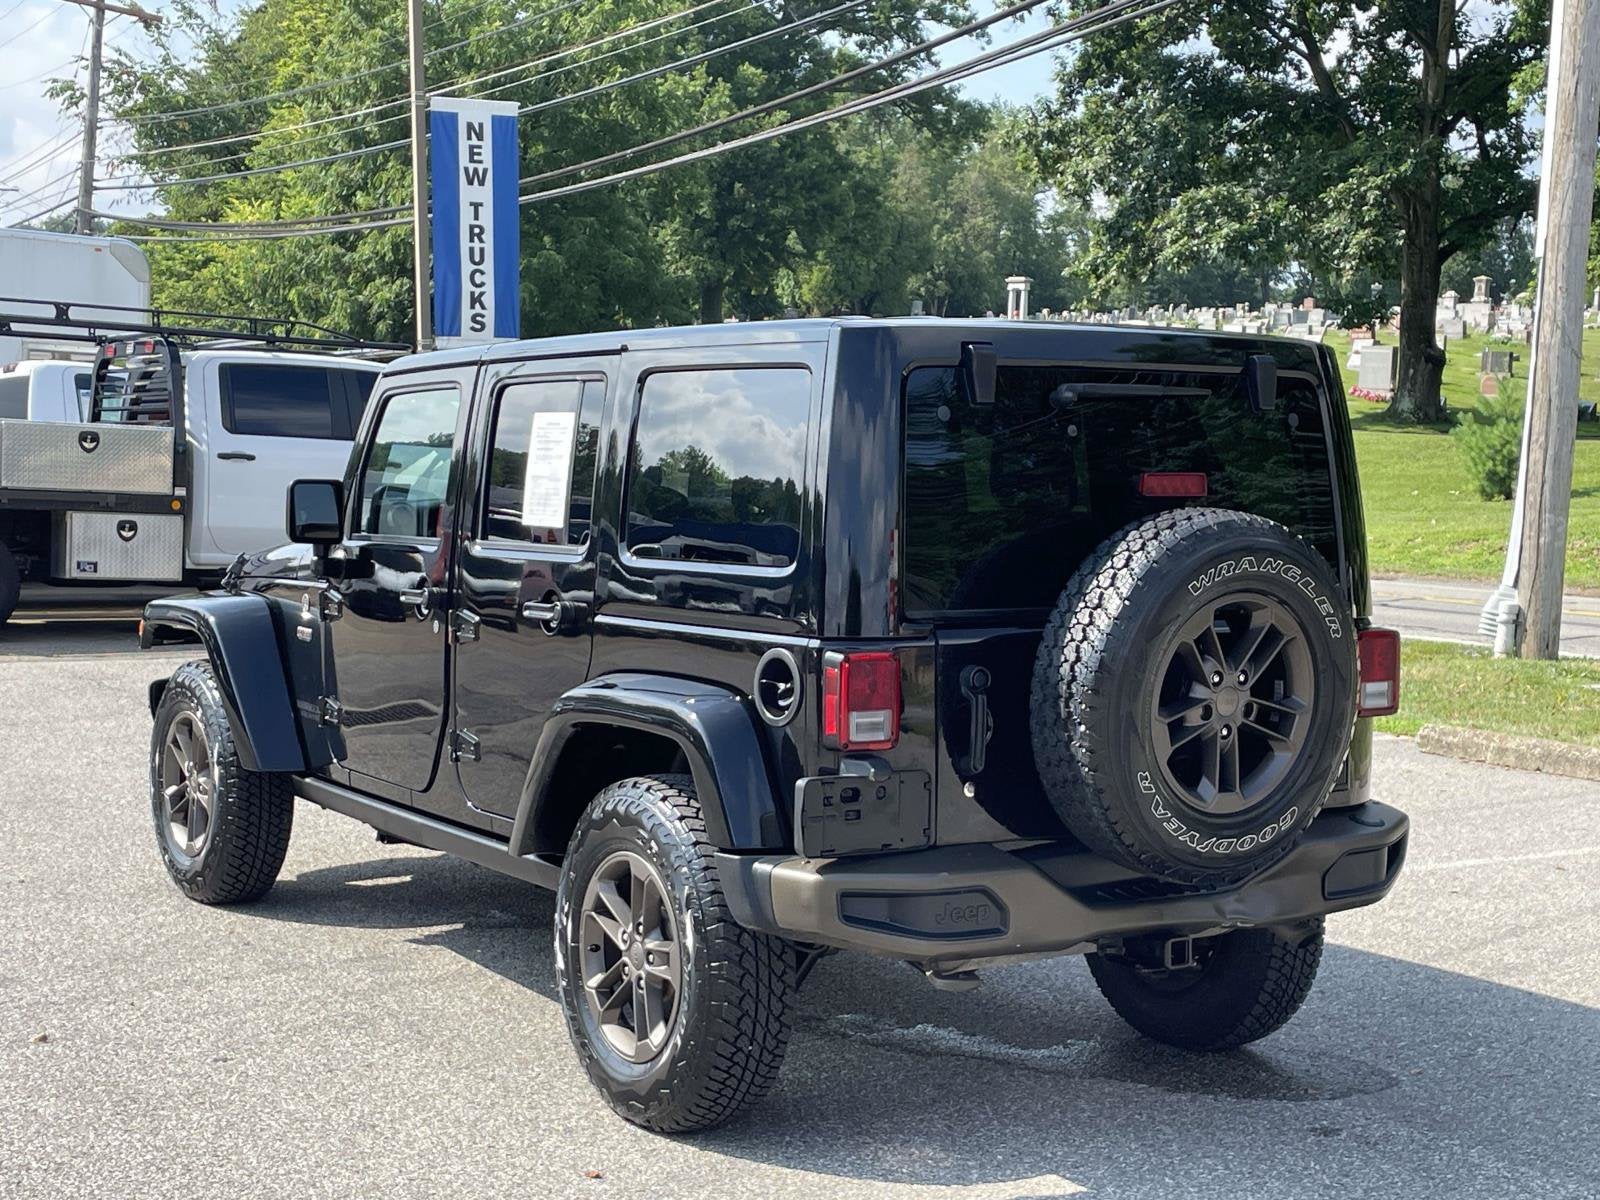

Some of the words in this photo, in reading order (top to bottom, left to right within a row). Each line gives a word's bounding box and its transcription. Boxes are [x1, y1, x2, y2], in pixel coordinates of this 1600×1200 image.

[463, 121, 489, 187] NEW
[468, 201, 488, 333] TRUCKS
[1187, 556, 1342, 639] WRANGLER
[1137, 771, 1298, 853] GOODYEAR
[935, 902, 990, 925] Jeep
